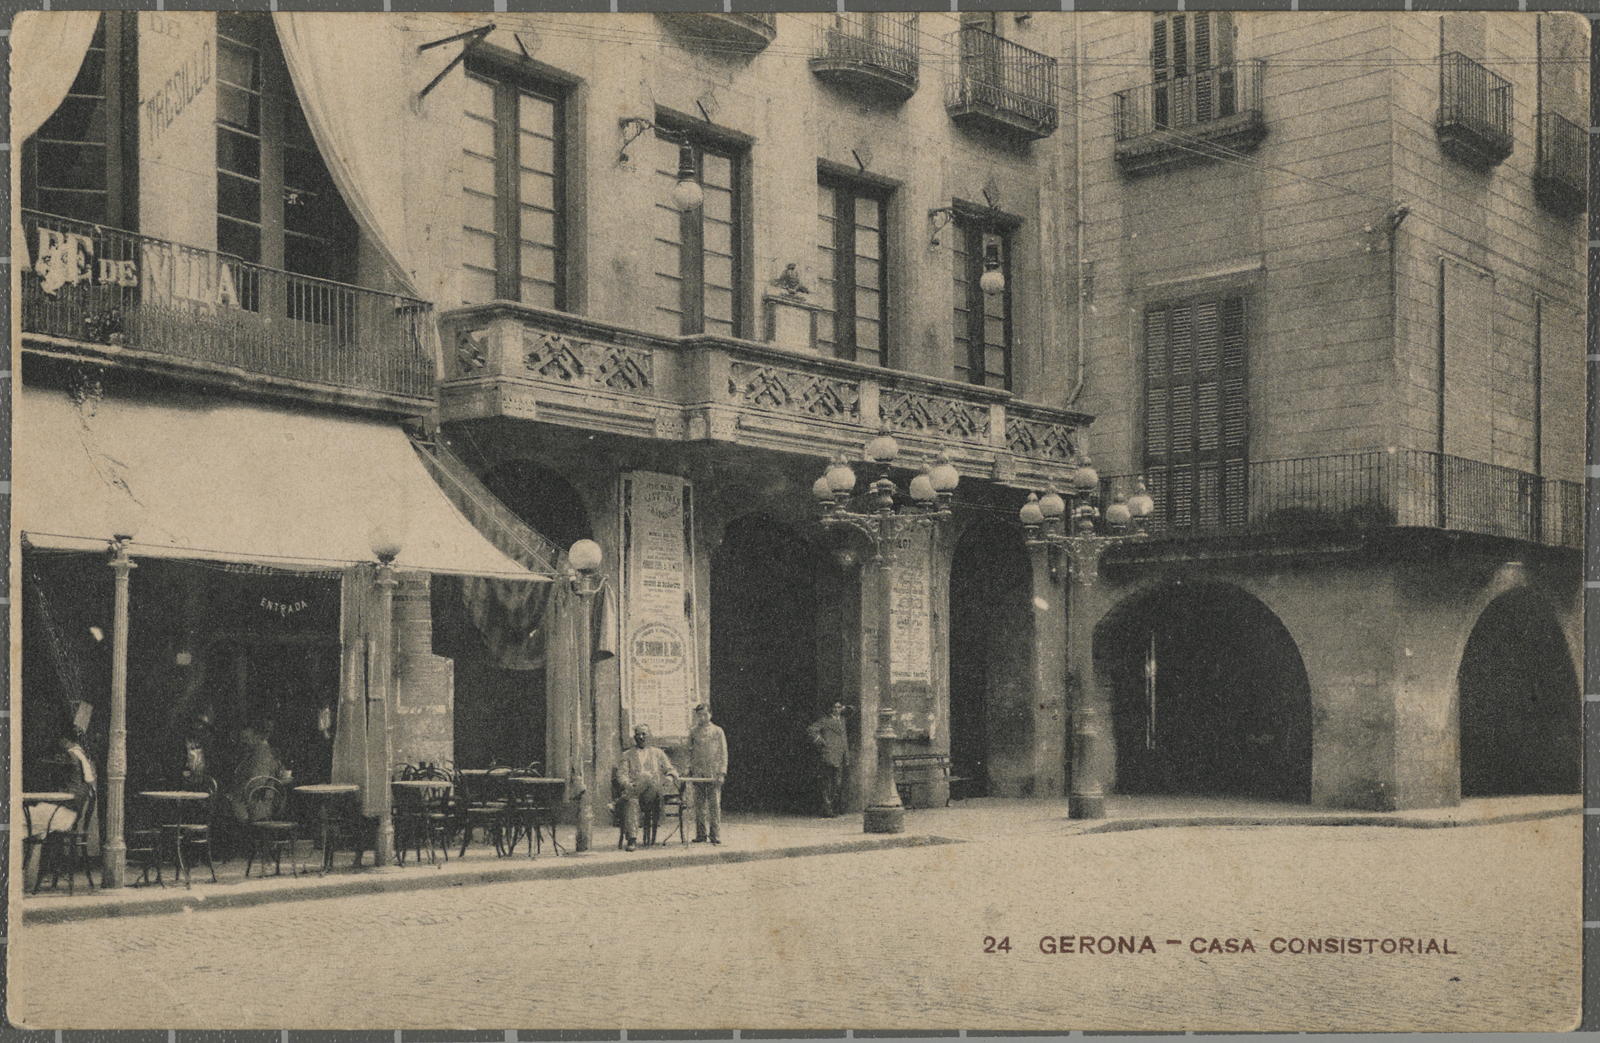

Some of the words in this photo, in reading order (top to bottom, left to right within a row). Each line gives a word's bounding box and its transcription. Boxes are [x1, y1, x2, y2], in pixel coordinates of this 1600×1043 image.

[145, 38, 212, 147] TRESILLO
[98, 258, 138, 288] DE
[260, 597, 308, 617] ENTRADA
